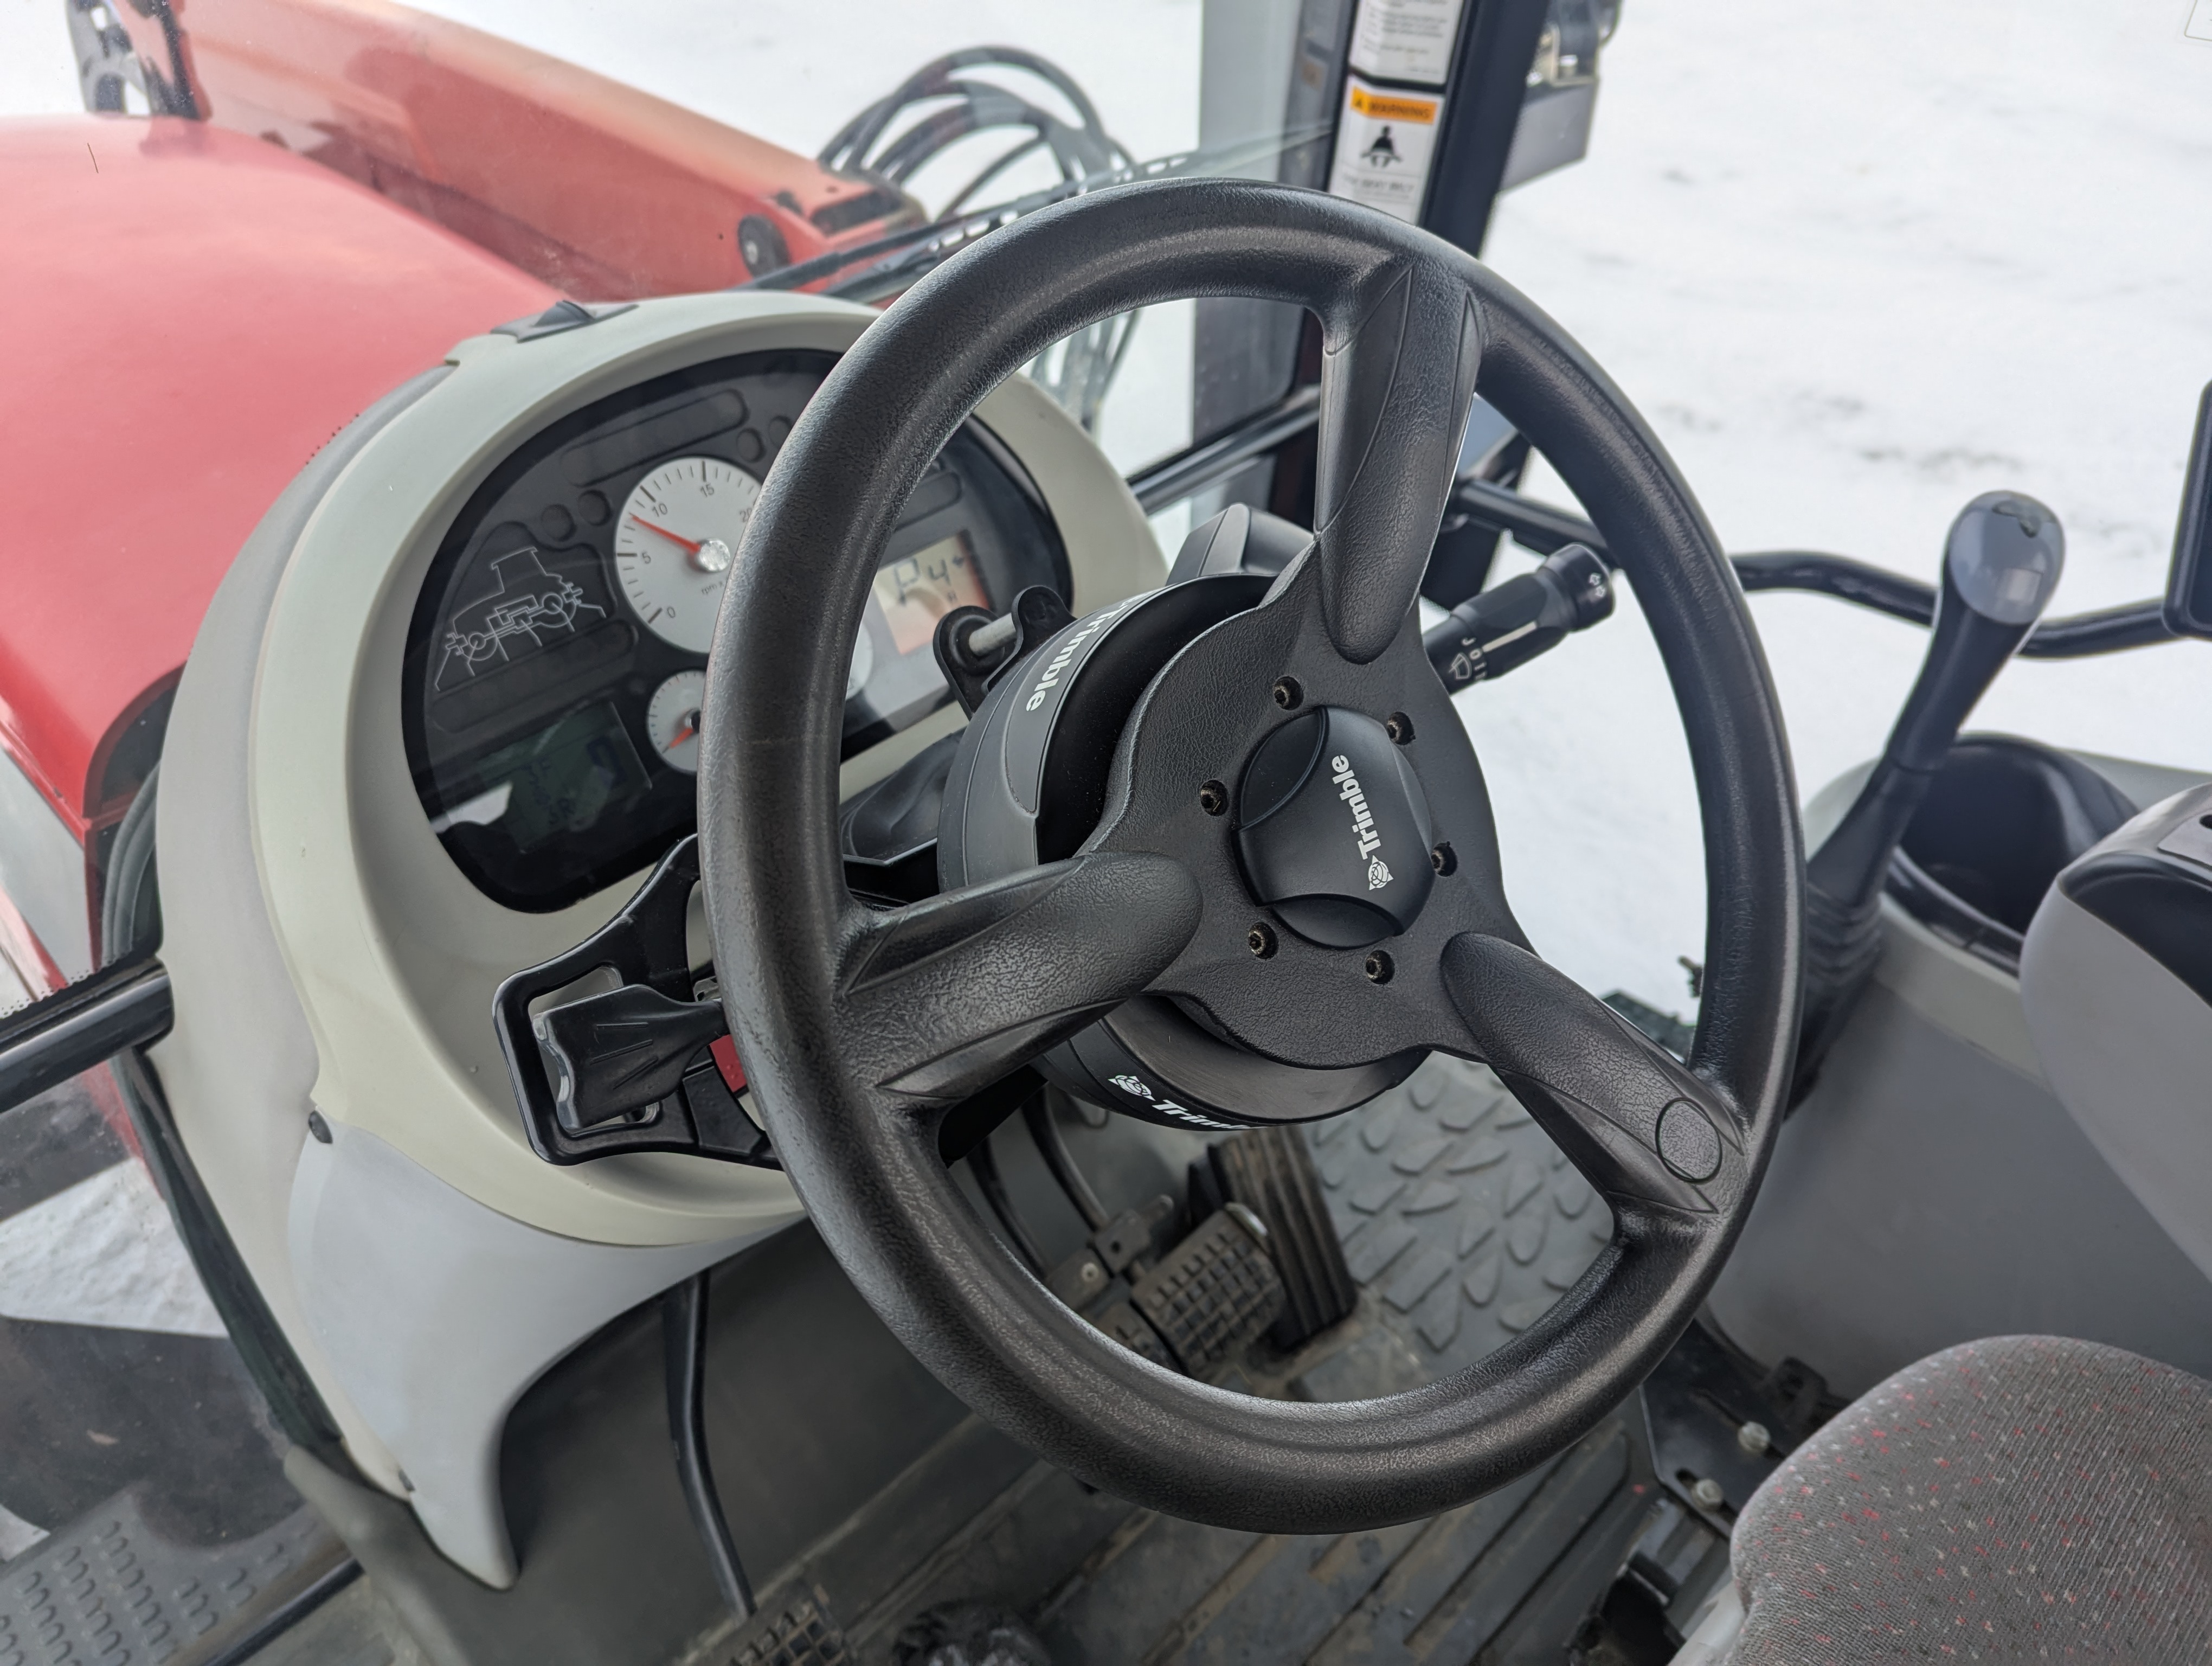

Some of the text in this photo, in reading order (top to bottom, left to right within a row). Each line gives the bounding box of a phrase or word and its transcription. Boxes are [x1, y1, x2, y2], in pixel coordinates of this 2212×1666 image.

[1369, 102, 1431, 119] WARNING
[700, 484, 715, 497] 15
[652, 503, 668, 517] 10
[642, 552, 651, 564] 5
[701, 584, 718, 595] rpm
[666, 607, 676, 619] 0
[1026, 605, 1128, 712] Trimble
[1332, 754, 1381, 860] Trimble
